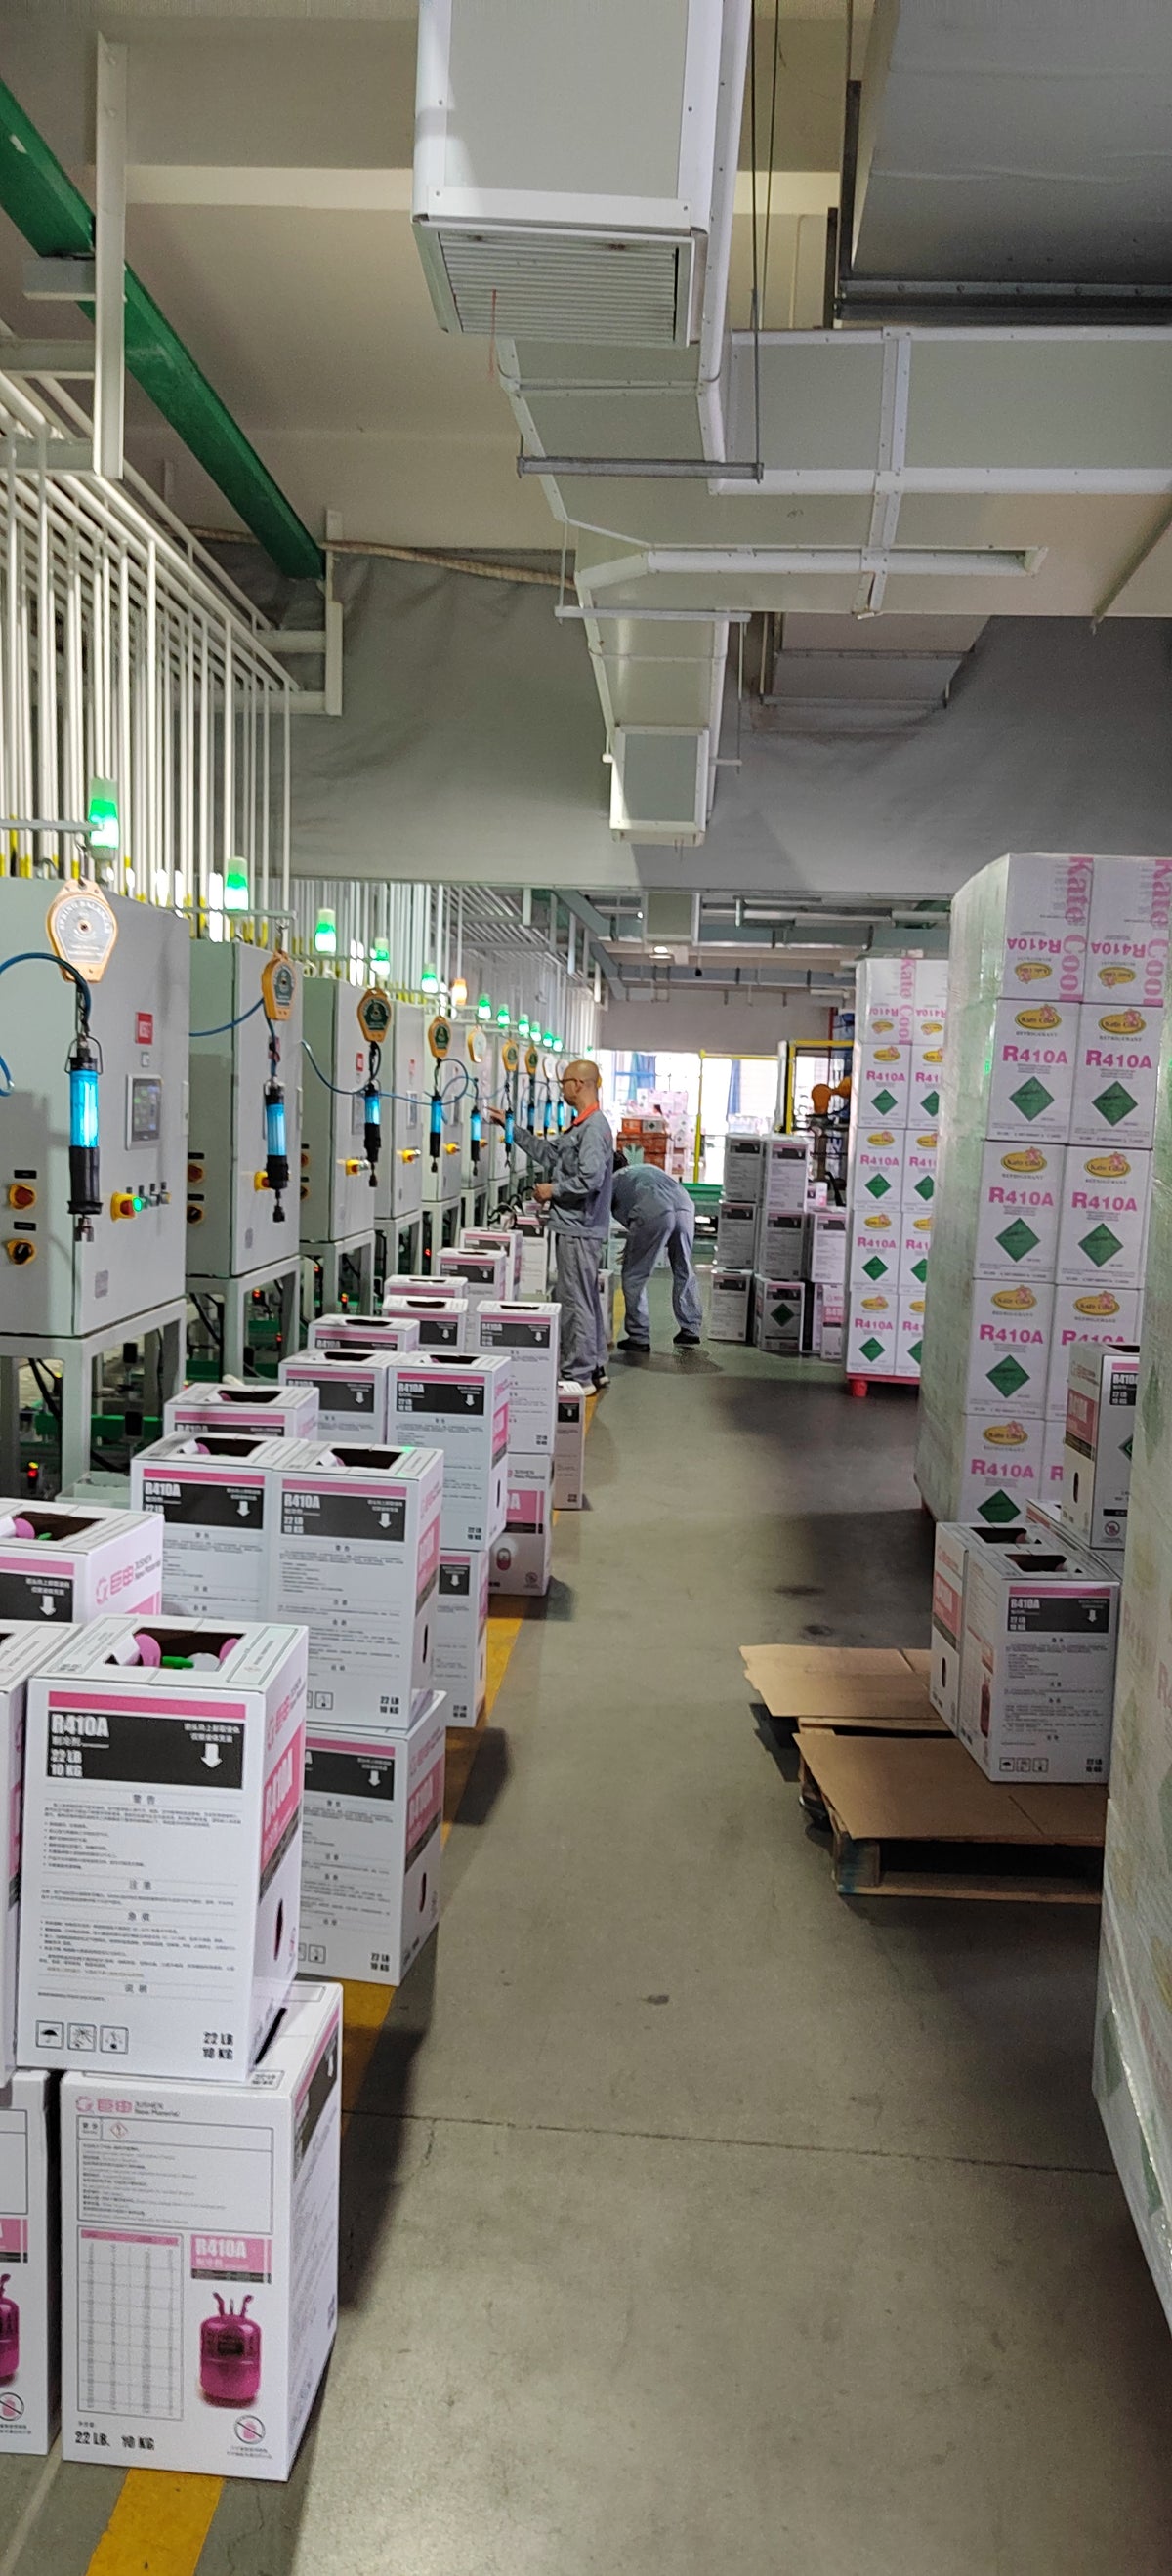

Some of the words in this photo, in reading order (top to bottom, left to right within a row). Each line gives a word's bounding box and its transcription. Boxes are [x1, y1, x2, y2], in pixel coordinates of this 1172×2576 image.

[1007, 938, 1062, 954] R410A
[1091, 942, 1147, 958] R410A
[1002, 1045, 1067, 1064] R410A
[1085, 1049, 1152, 1069] R410A
[866, 1070, 905, 1082] R410A
[915, 1072, 939, 1083] R41
[860, 1155, 899, 1166] R410A
[988, 1186, 1054, 1207] R410A
[1071, 1191, 1137, 1212] R410A
[858, 1237, 896, 1249] R410A
[906, 1239, 930, 1250] R41
[855, 1318, 893, 1330] R410A
[980, 1324, 1044, 1344] R410A
[971, 1459, 1034, 1478] R410A
[145, 1481, 182, 1497] R410A
[283, 1493, 321, 1509] R410A
[51, 1713, 109, 1738] R410A
[50, 1749, 65, 1763] 22
[66, 1749, 82, 1764] LB
[51, 1763, 64, 1776] 10
[64, 1764, 83, 1778] KG
[203, 2031, 218, 2045] 22
[220, 2032, 234, 2046] LB
[203, 2047, 216, 2058] 10
[218, 2048, 234, 2060] KG
[196, 2237, 247, 2259] R410A
[74, 2431, 91, 2445] 22
[121, 2435, 135, 2449] 10
[138, 2436, 154, 2451] KG
